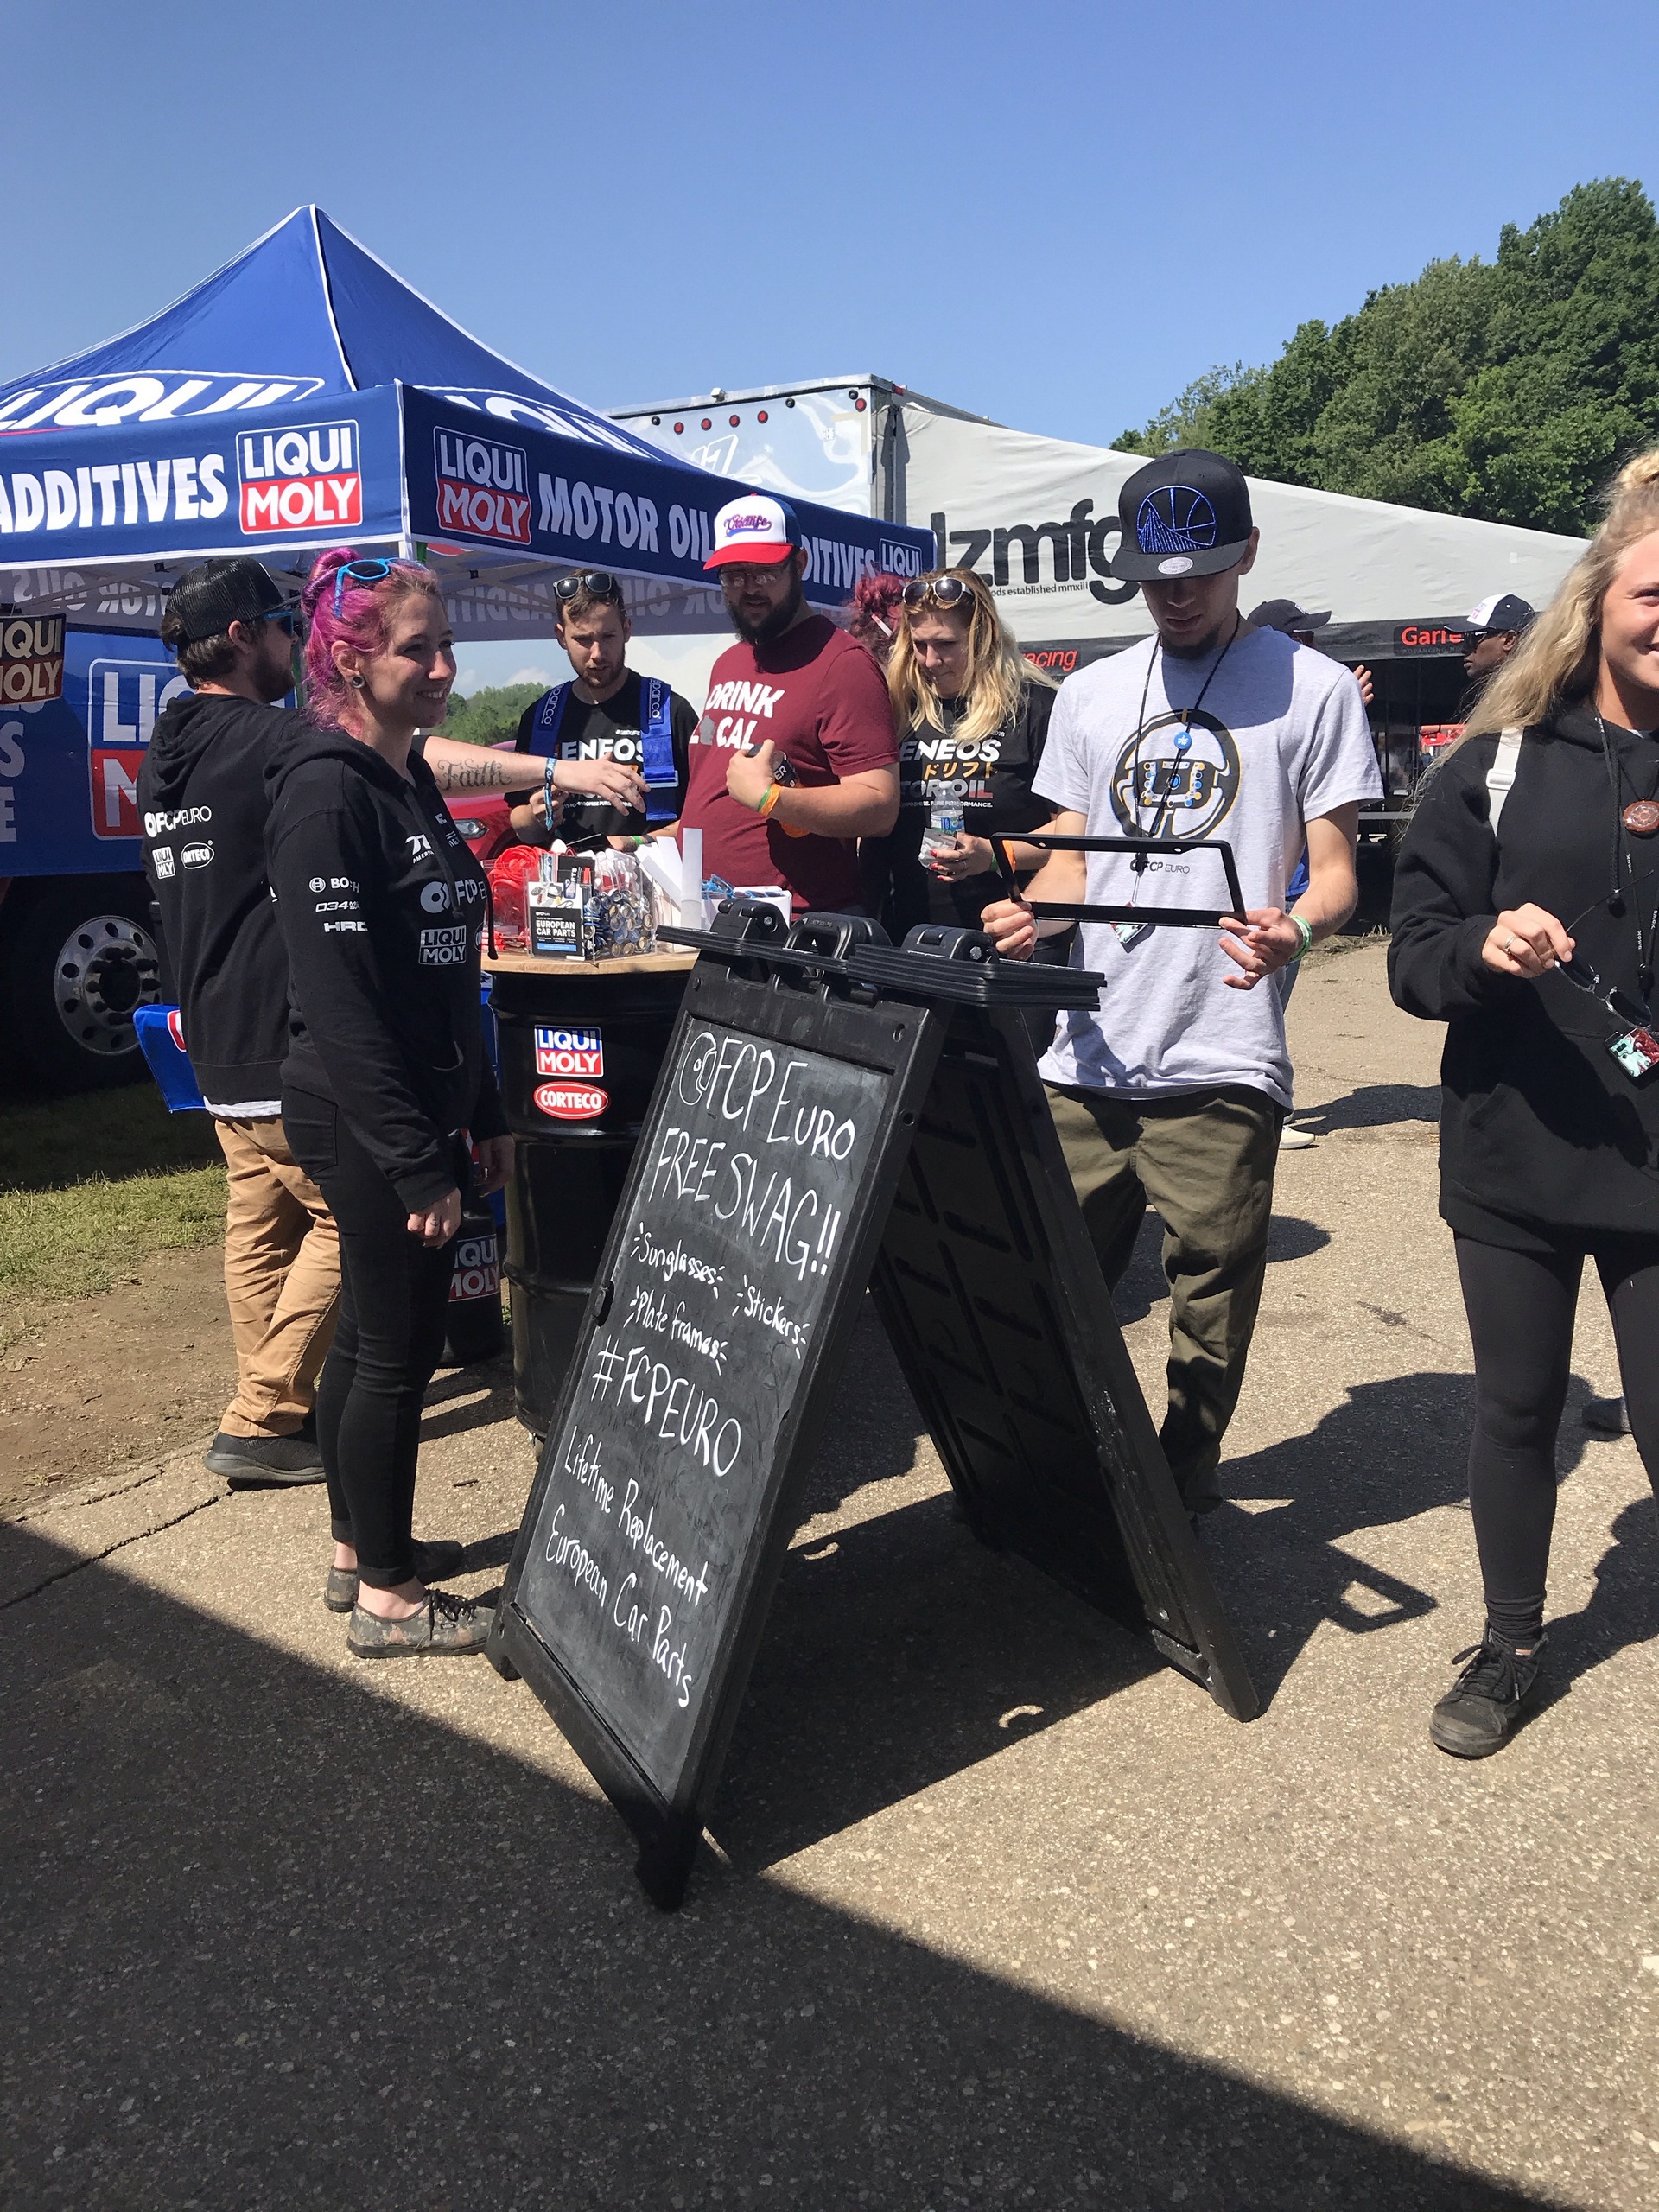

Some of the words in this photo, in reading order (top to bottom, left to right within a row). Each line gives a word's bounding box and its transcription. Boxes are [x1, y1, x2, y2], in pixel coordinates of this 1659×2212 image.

[244, 427, 352, 478] LIQUI
[440, 434, 524, 493] LIQUI
[247, 477, 358, 526] MOLY
[443, 483, 529, 537] MOLY
[538, 473, 659, 553] MOTOR
[881, 543, 919, 578] LIQUI
[1007, 583, 1057, 596] established
[1058, 582, 1090, 593] mmxiii
[705, 680, 785, 718] DRINK
[900, 739, 1001, 762] ENEOS
[436, 758, 512, 791] Faith
[952, 779, 994, 798] OIL
[183, 848, 210, 863] ORTECO
[1165, 864, 1191, 874] EURO
[423, 928, 466, 947] LIQUI
[536, 920, 575, 930] EUROPEAN
[553, 929, 576, 938] PARTS
[422, 945, 466, 964] MOLY
[537, 1027, 598, 1052] LIQUI
[540, 1052, 600, 1074] MOLY
[540, 1090, 603, 1110] CORTECO
[648, 1128, 726, 1203] FREE
[715, 1152, 842, 1281] SWAG!!
[638, 1230, 718, 1286] Sunglasses
[634, 1293, 667, 1332] Plate
[744, 1287, 804, 1345] Stickers
[591, 1334, 741, 1477] #FCPEURO
[618, 1478, 709, 1607] Replacement
[545, 1504, 608, 1608] European
[613, 1572, 649, 1643] Car
[652, 1605, 691, 1708] Parts
